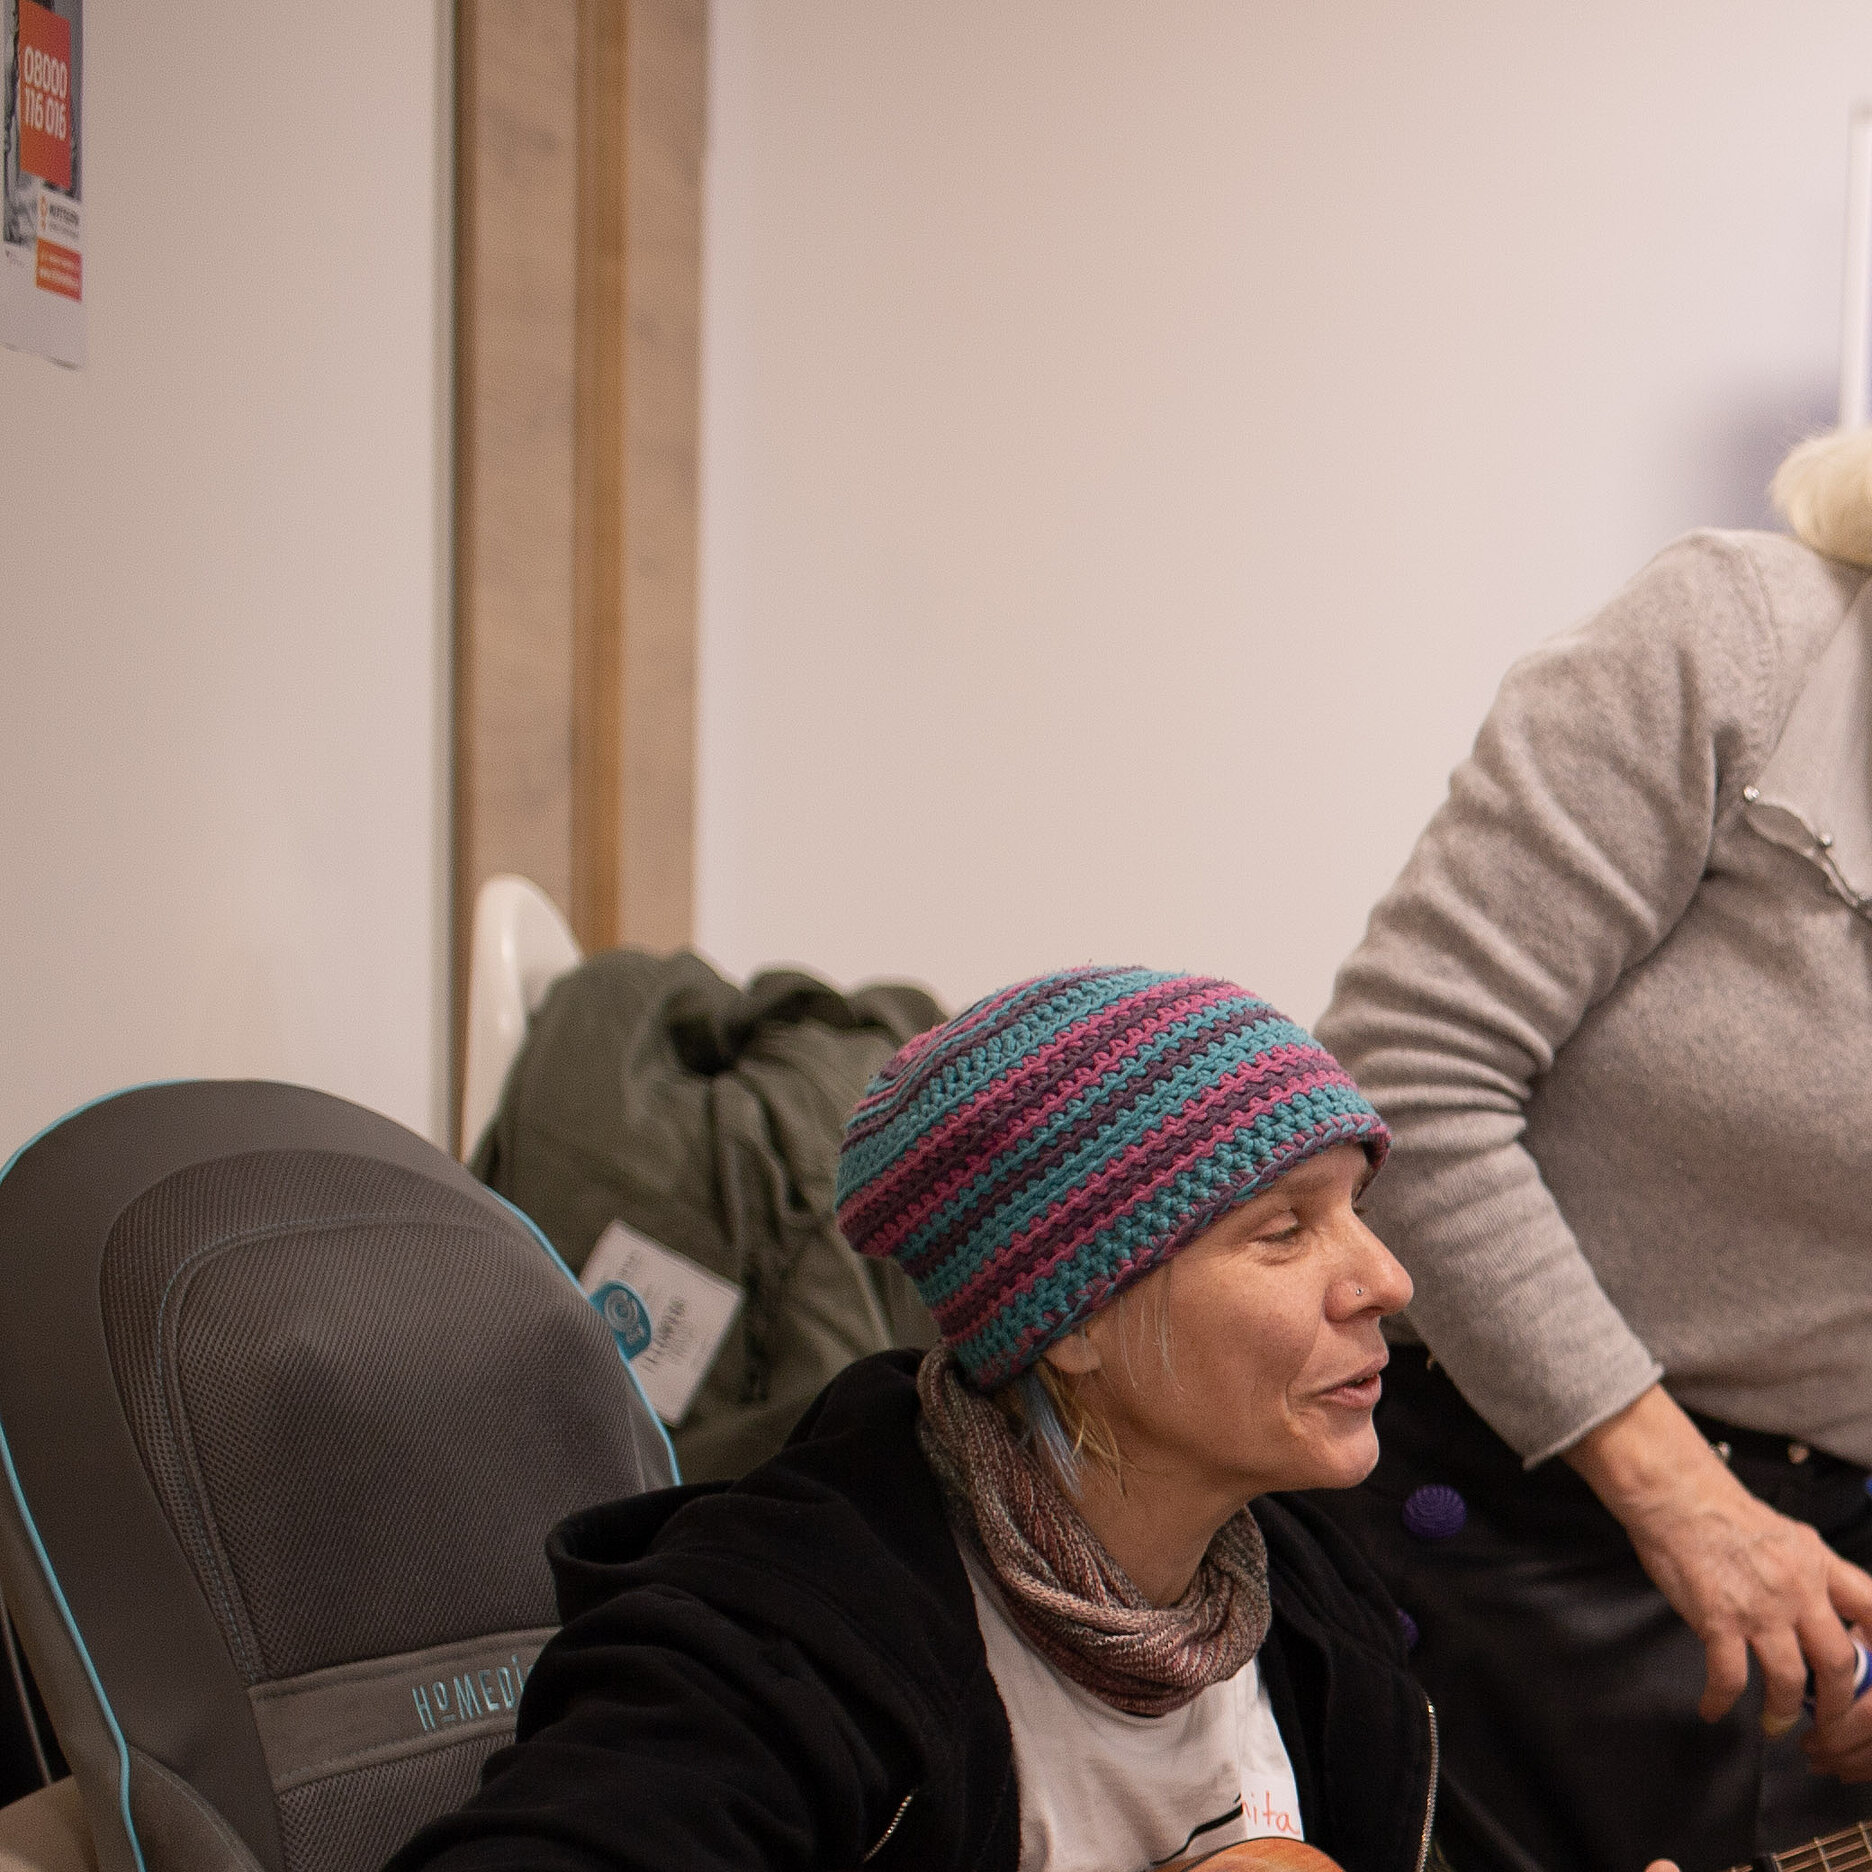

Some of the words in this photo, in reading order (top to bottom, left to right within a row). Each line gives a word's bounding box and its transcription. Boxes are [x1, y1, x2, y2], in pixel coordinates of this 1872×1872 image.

[24, 45, 68, 100] 08000
[25, 87, 44, 131] 116
[45, 97, 66, 141] 016
